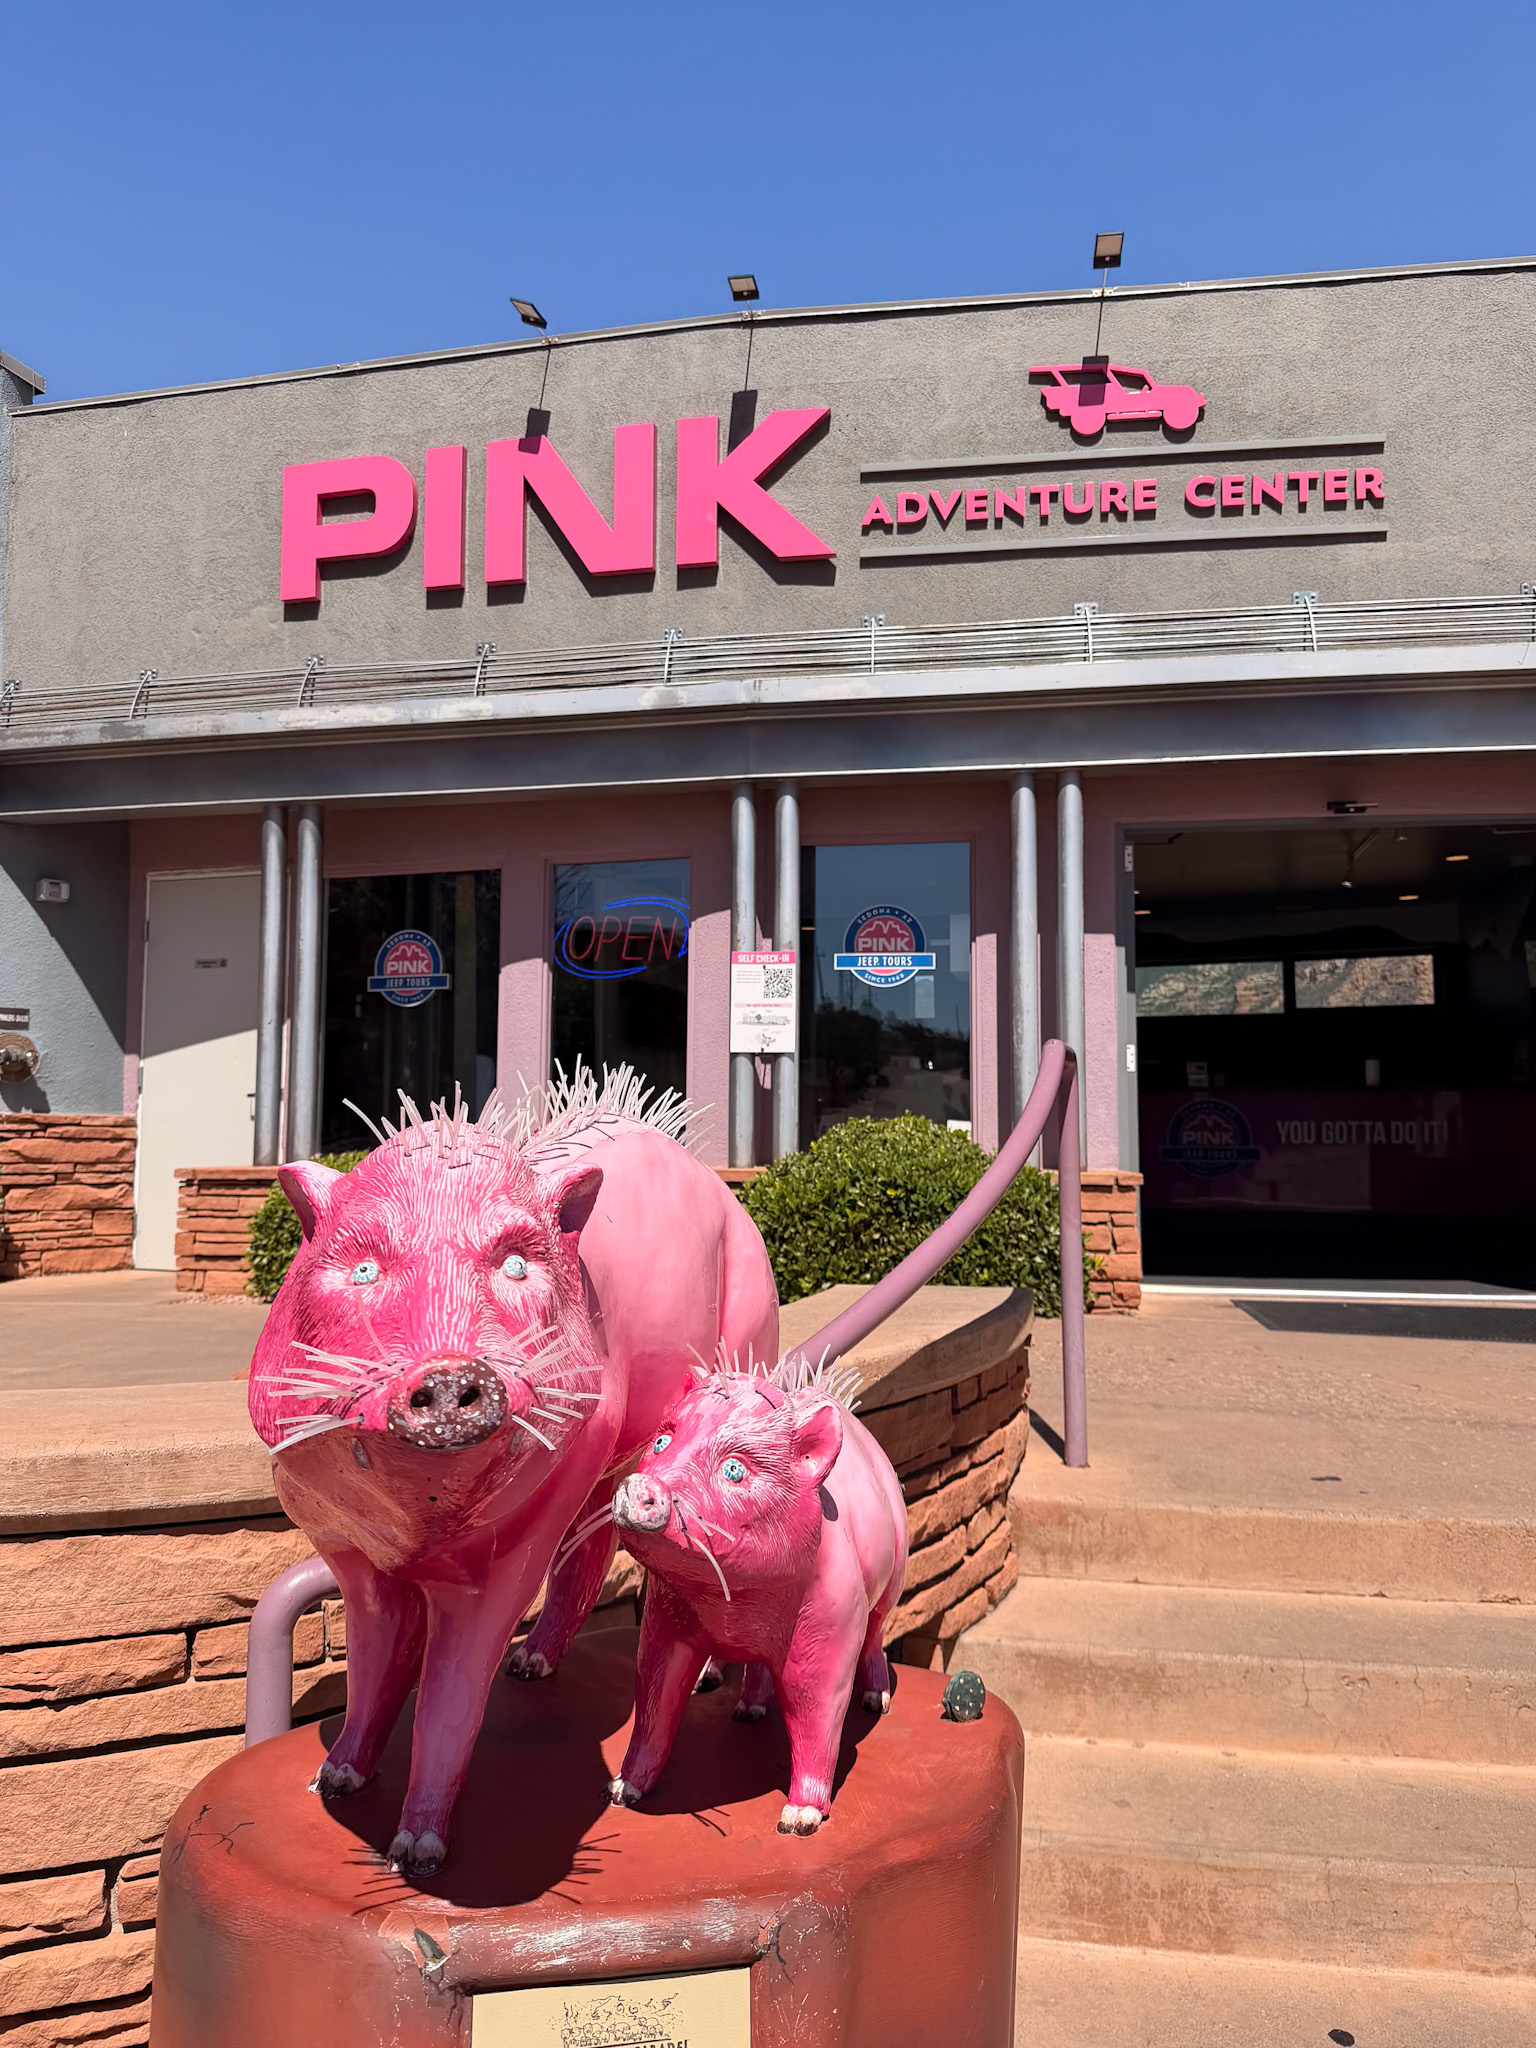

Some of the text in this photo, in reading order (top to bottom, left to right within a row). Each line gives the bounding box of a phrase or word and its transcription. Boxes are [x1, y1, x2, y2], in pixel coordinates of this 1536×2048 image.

[861, 468, 1386, 526] ADVENTURE CENTER
[280, 407, 837, 603] PINK
[857, 908, 914, 924] SEDONA AZ
[568, 915, 677, 962] OPEN
[857, 937, 910, 952] PINK
[737, 954, 790, 963] SELF CHECK-IN
[882, 956, 912, 966] TOURS
[387, 959, 429, 974] PINK
[405, 977, 430, 987] TOURS
[864, 973, 885, 983] SINCE
[1182, 1131, 1234, 1145] PINK
[1276, 1120, 1316, 1145] YOU
[1321, 1120, 1387, 1145] GOTTA
[1390, 1120, 1417, 1145] DO
